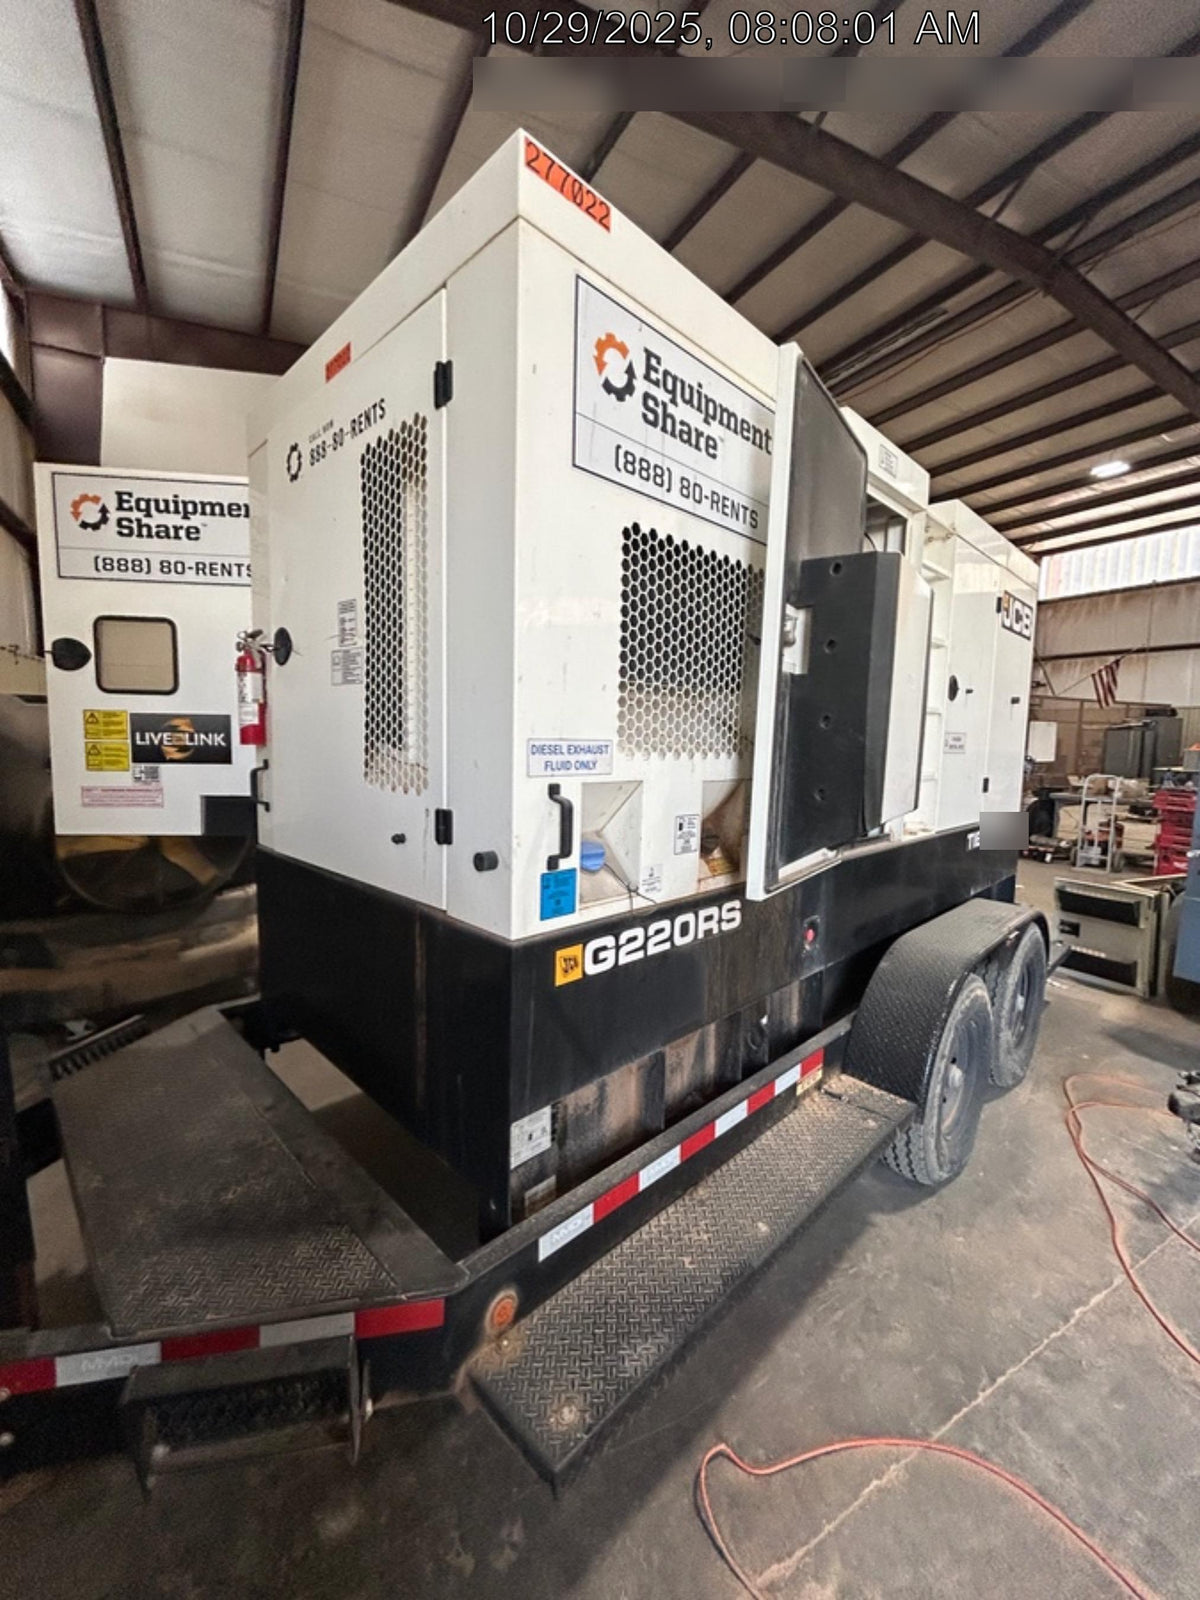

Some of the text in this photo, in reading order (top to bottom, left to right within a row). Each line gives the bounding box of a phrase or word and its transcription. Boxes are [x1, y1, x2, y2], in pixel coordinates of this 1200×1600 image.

[643, 346, 772, 455] Equipment
[309, 398, 386, 466] 888-80-RENTS
[641, 391, 718, 459] Share
[614, 444, 758, 529] (888) 80-RENTS
[116, 517, 200, 541] Share
[94, 555, 151, 574] (888)
[1003, 592, 1032, 637] JCB
[136, 732, 226, 746] LIVE LINK
[531, 744, 608, 755] DIESEL EXHAUST
[544, 760, 597, 771] FLUID ONLY
[584, 900, 742, 976] G220RS
